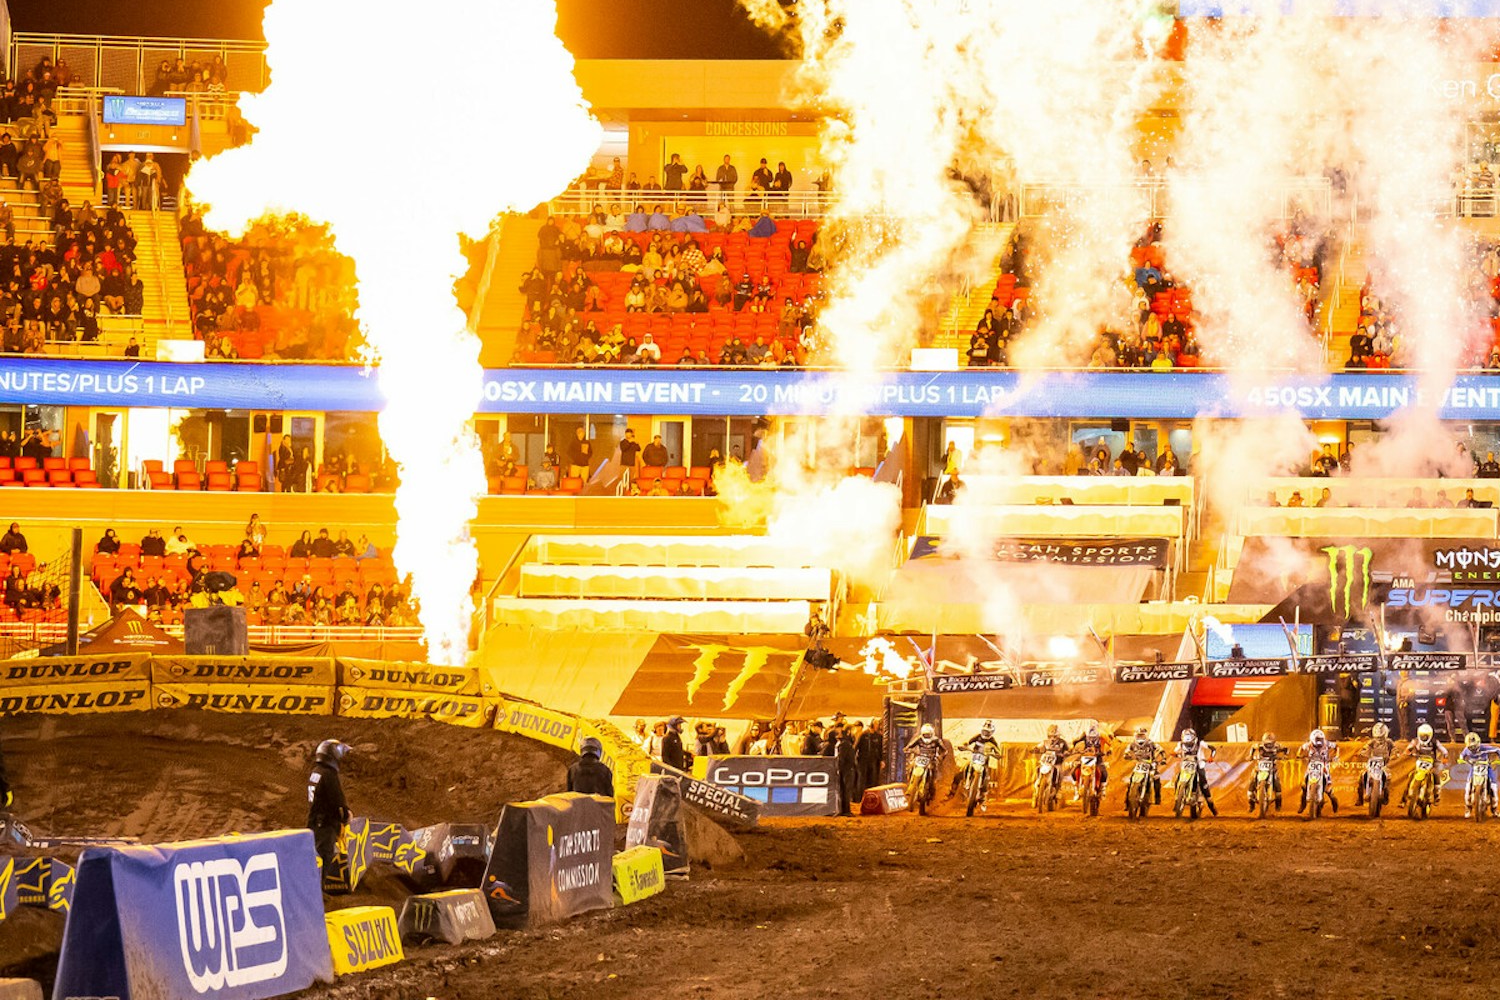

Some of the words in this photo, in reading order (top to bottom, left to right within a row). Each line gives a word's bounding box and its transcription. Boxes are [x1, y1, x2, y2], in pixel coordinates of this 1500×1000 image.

[705, 121, 788, 137] CONCESSIONS
[161, 376, 205, 394] LAP
[481, 381, 537, 401] 0SX
[543, 382, 613, 402] MAIN
[620, 382, 705, 402] EVENT
[739, 384, 767, 403] 20
[963, 385, 1005, 404] LAP
[1247, 386, 1333, 407] 450SX
[1339, 386, 1408, 407] MAIN
[997, 550, 1154, 563] COMMISSION
[1071, 545, 1158, 556] SPORTS
[1392, 580, 1415, 588] AMA
[5, 661, 132, 680] DUNLOP
[193, 664, 314, 679] DUNLOP
[369, 668, 465, 687] DUNLOP
[0, 689, 146, 713] DUNLOP
[187, 693, 326, 711] DUNLOP
[361, 695, 479, 718] DUNLOP
[510, 709, 572, 740] DUNLOP
[714, 767, 830, 786] GoPro
[688, 780, 741, 810] SPECIAL
[173, 852, 289, 993] WPS
[342, 916, 399, 967] SUZUKI
